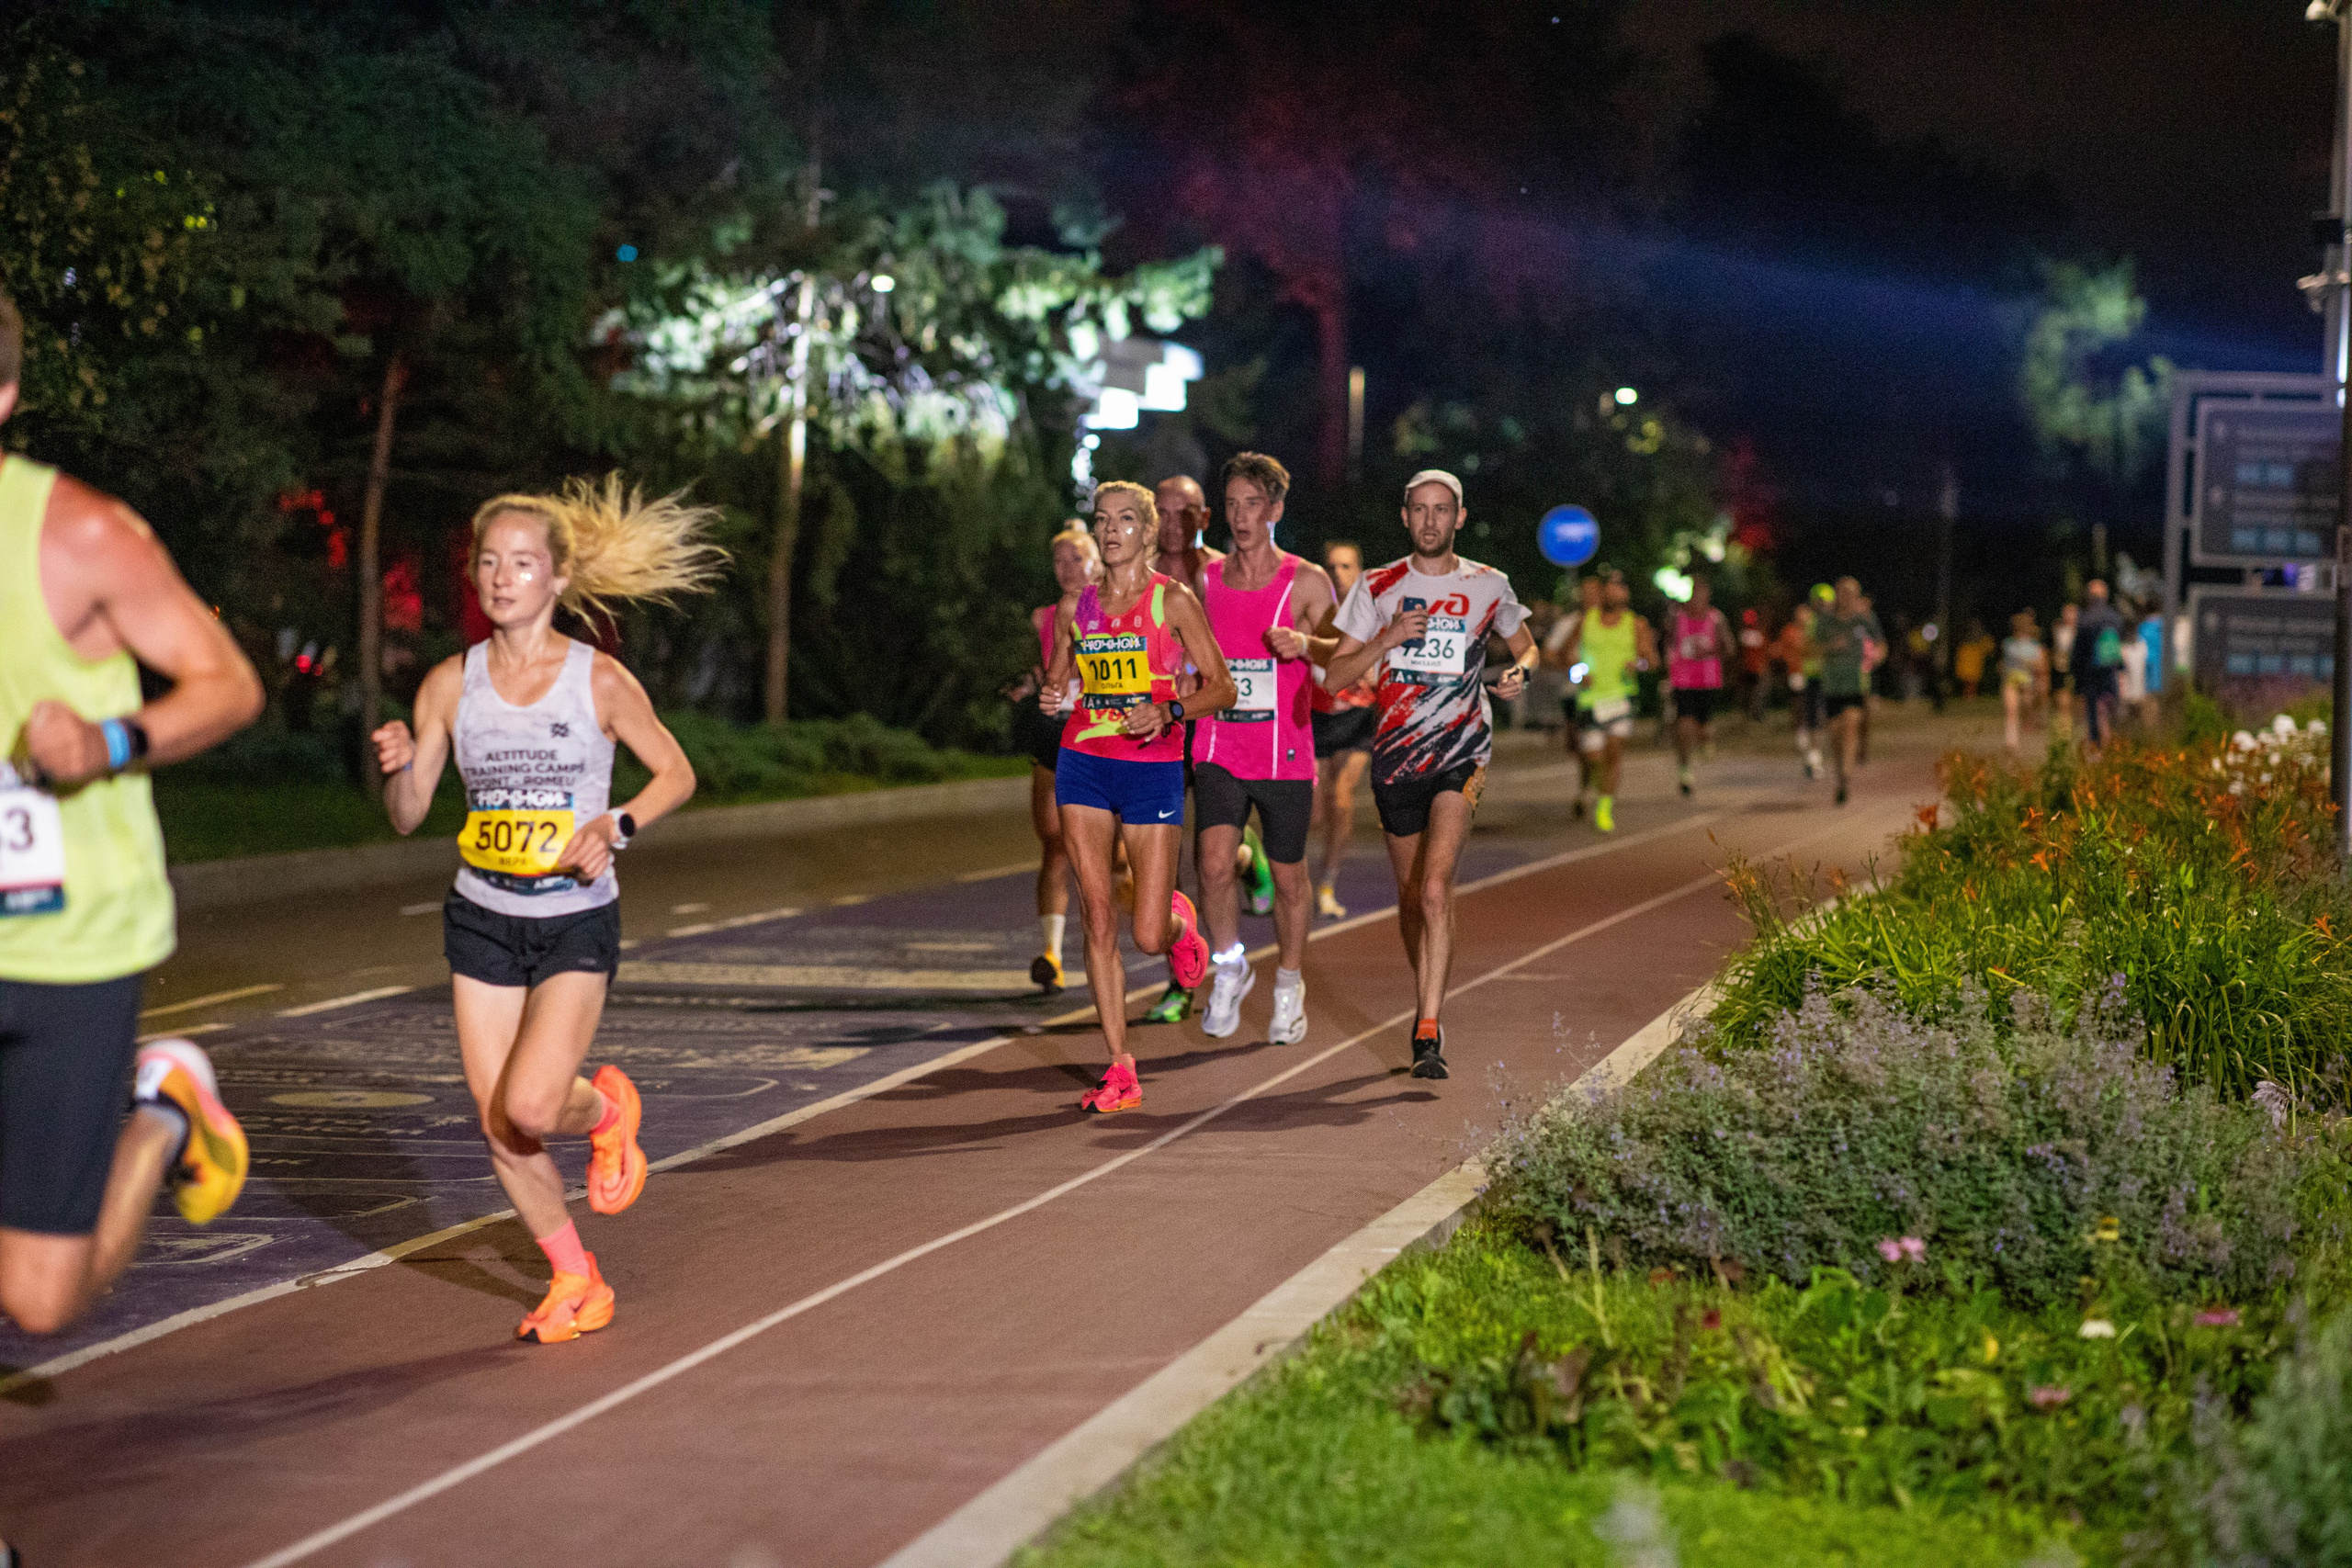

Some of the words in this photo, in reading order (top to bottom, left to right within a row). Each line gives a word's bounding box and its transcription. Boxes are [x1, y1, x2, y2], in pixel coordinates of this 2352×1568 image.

[1089, 658, 1137, 681] 1011
[486, 750, 557, 761] ALTITUDE
[464, 765, 531, 775] TRAINING
[535, 761, 585, 774] CAMPS
[523, 775, 575, 786] ROMEU
[0, 807, 34, 852] 3
[475, 820, 558, 852] 5072
